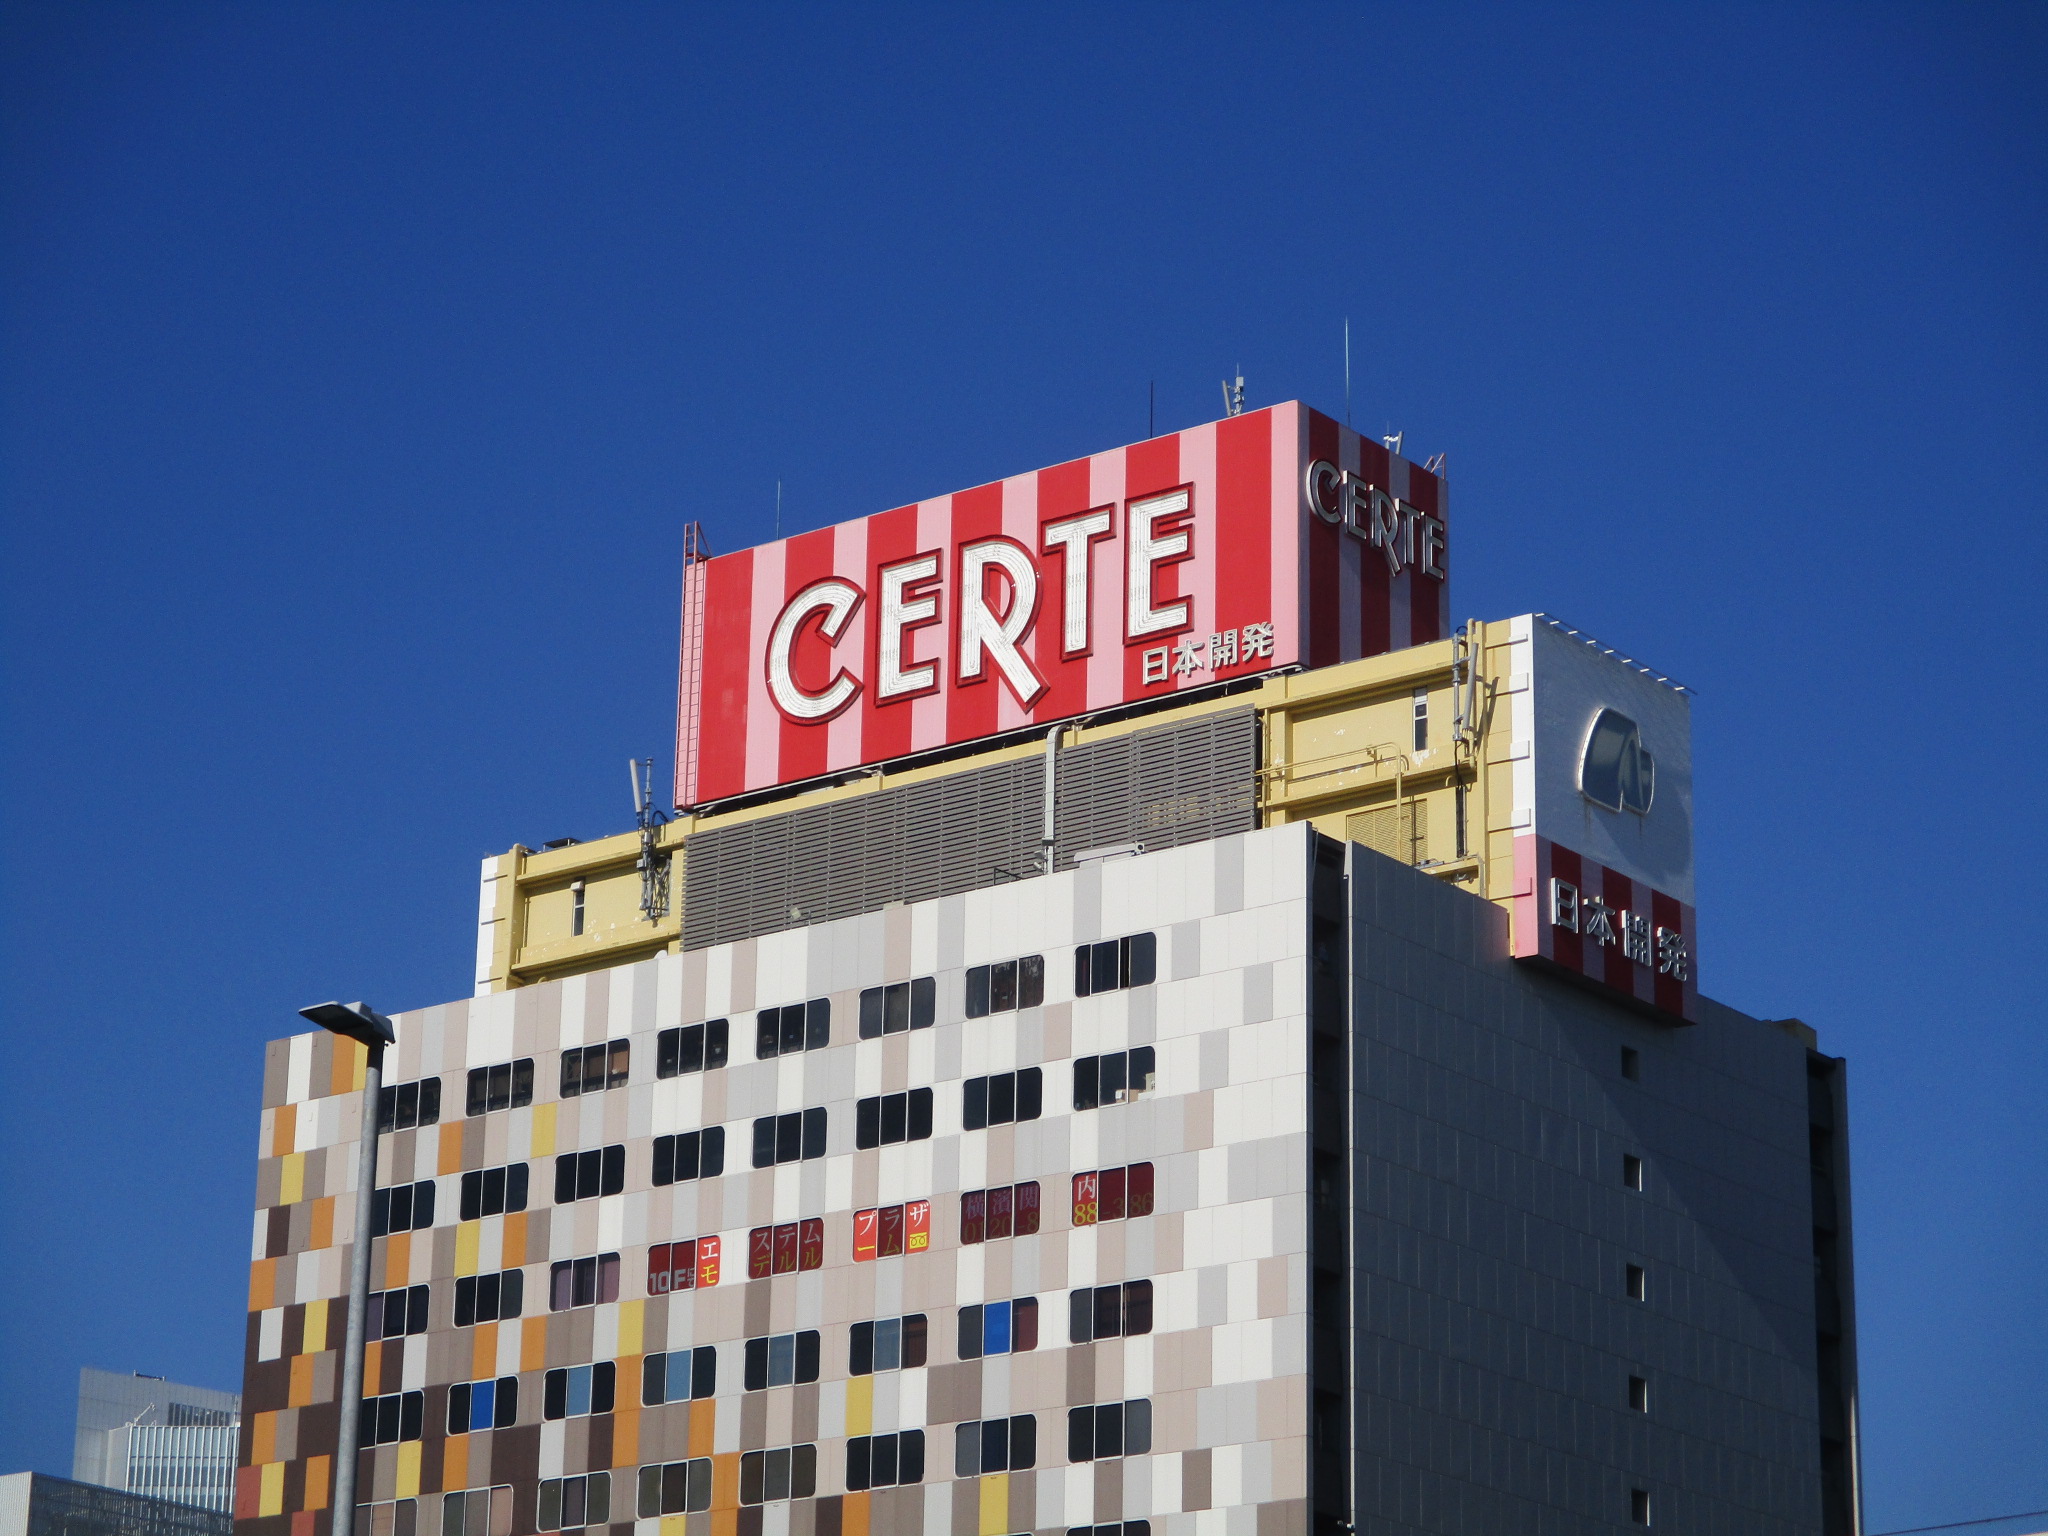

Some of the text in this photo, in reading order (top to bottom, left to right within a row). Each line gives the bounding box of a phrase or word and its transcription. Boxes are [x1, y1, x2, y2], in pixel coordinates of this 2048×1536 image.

[1306, 459, 1444, 580] CERTE
[766, 484, 1192, 723] CERTE
[1142, 621, 1274, 685] 日本開発
[1550, 877, 1688, 982] 日本開発
